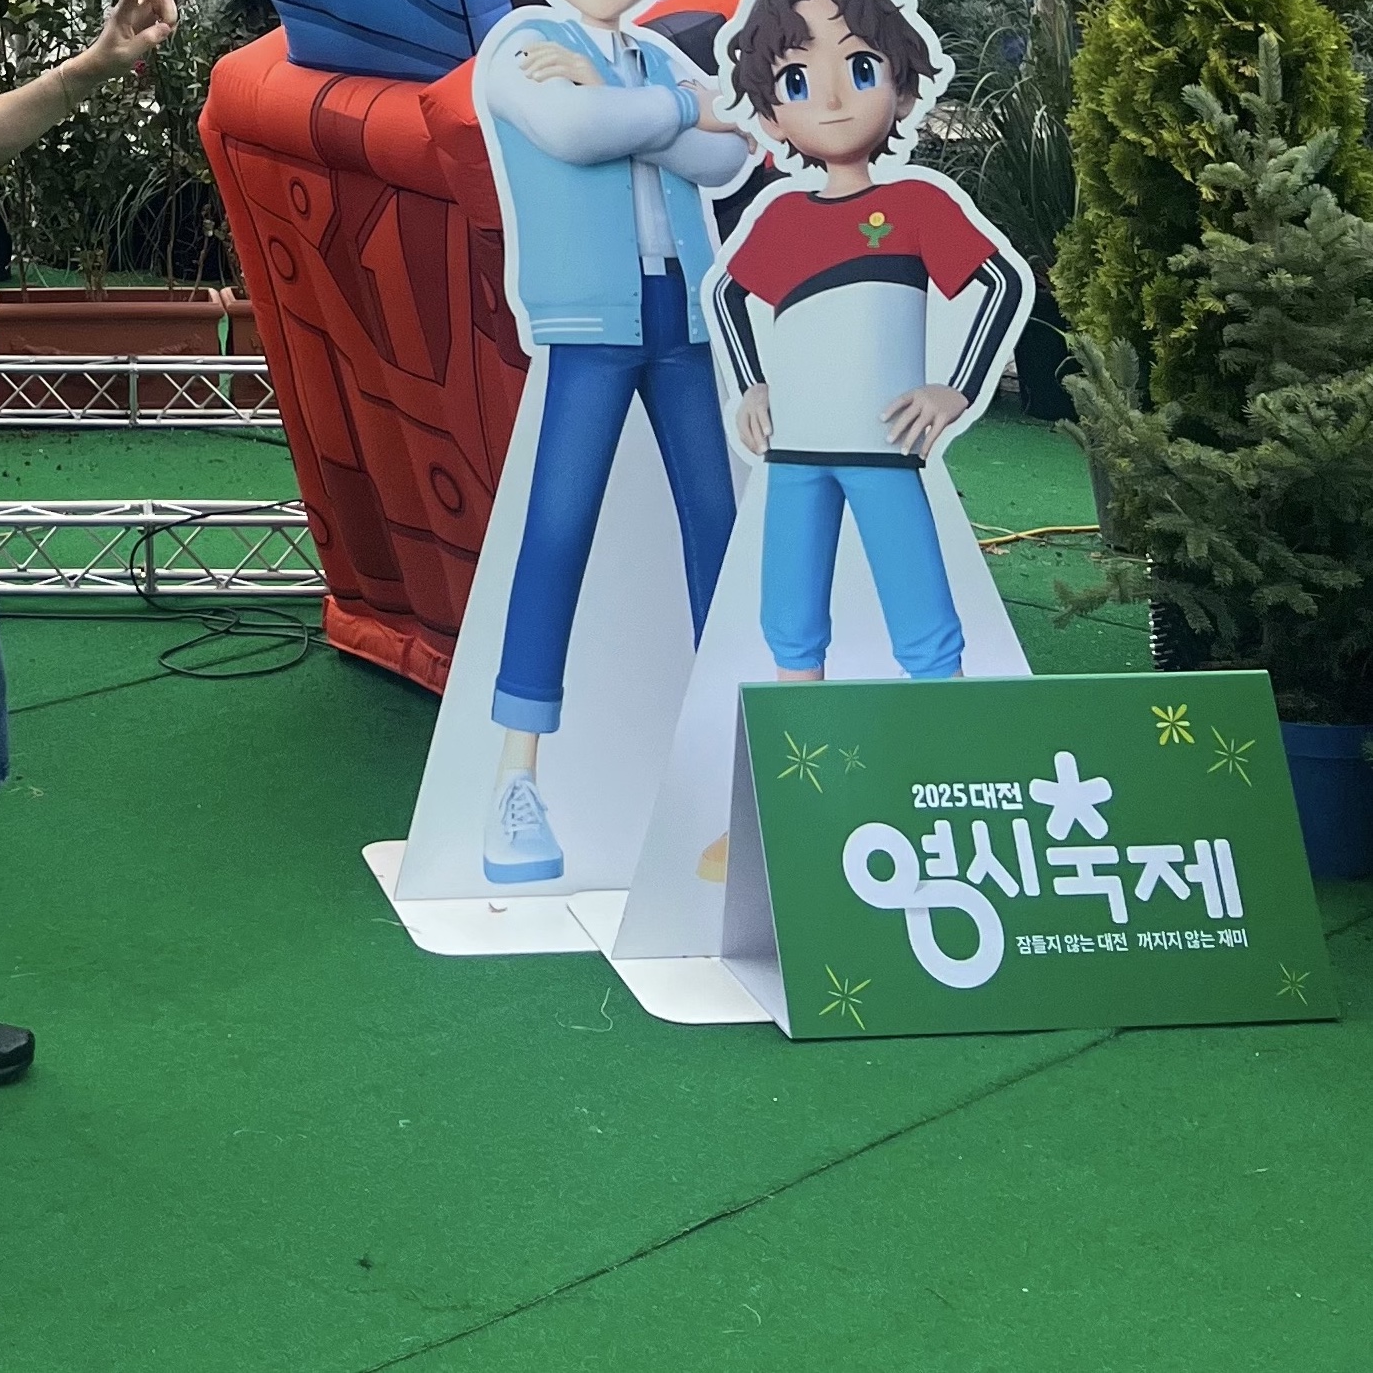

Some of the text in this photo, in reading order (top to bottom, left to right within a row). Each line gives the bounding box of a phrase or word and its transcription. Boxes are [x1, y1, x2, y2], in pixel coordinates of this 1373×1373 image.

[1016, 928, 1249, 955] 잠들지 않는 대전 꺼지지 않는 재미
